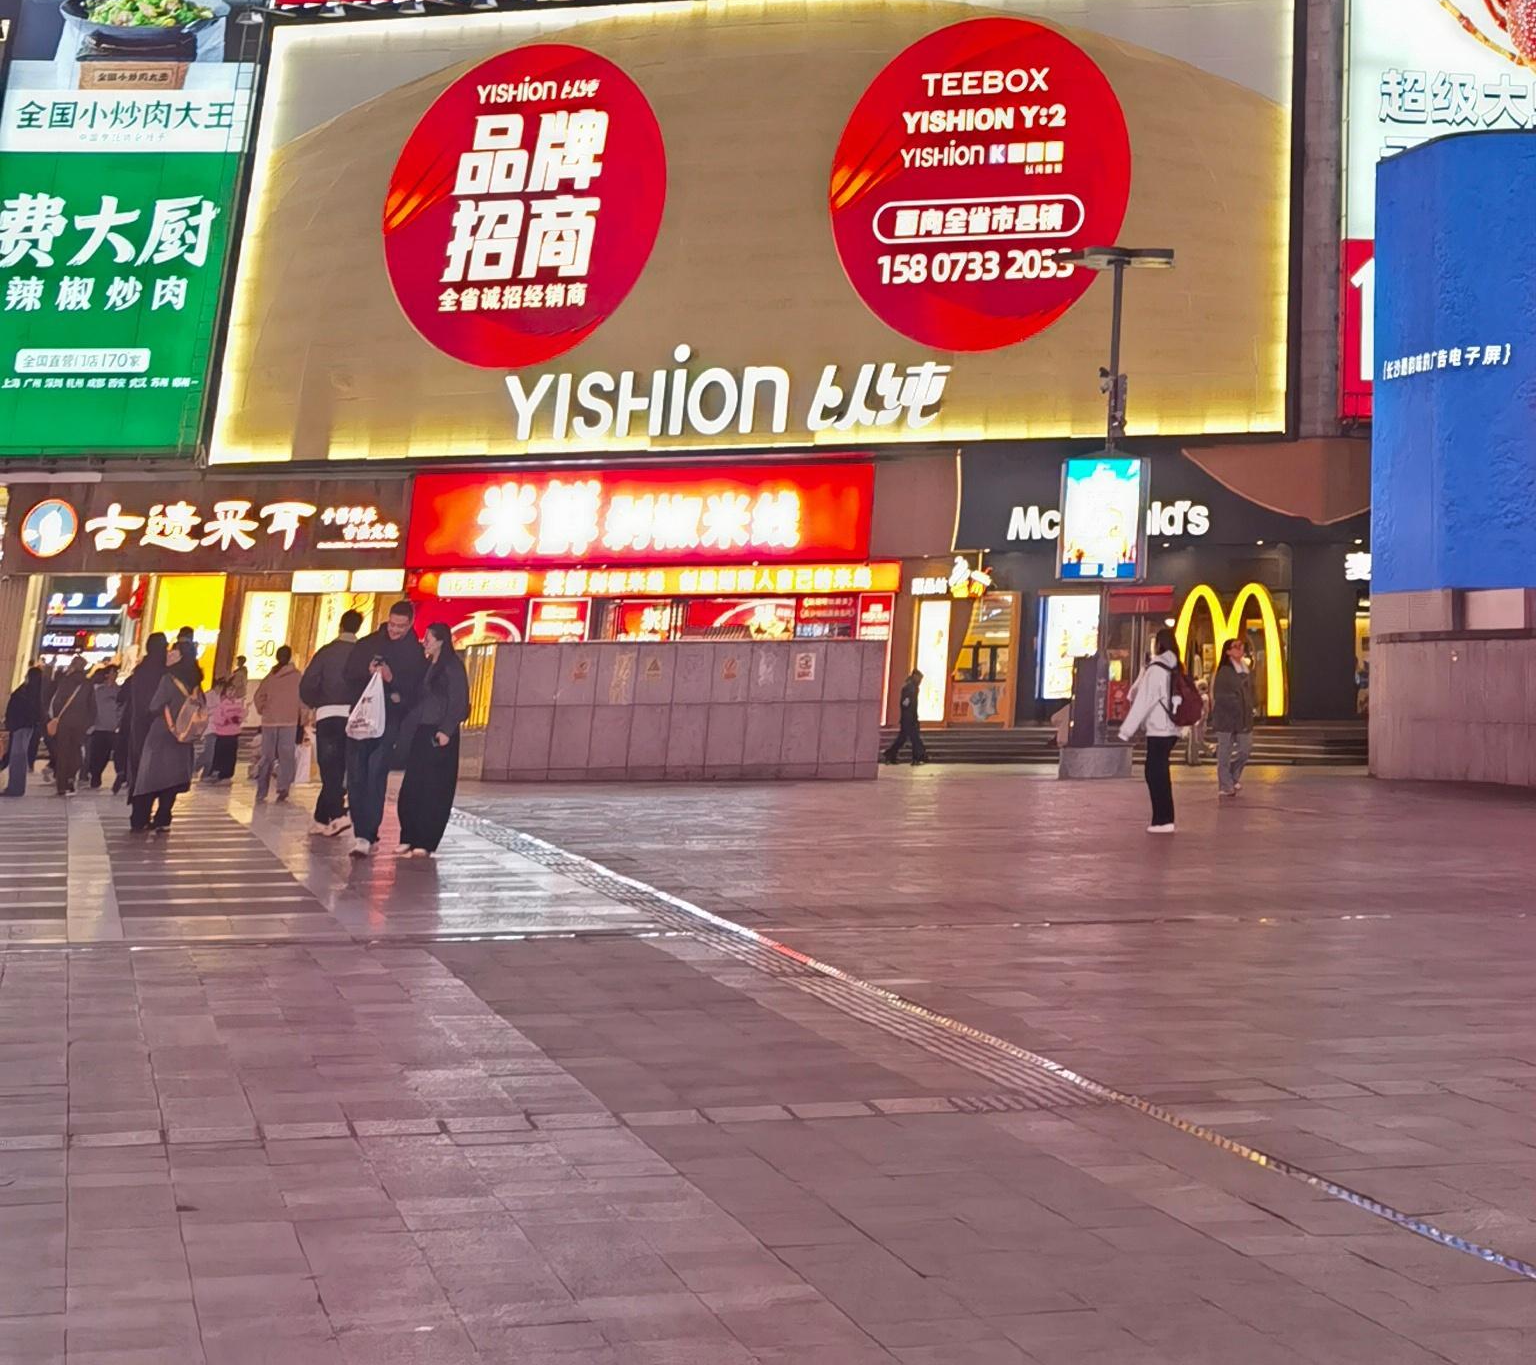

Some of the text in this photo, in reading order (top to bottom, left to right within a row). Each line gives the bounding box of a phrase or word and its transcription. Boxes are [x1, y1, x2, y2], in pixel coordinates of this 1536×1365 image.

[922, 67, 1050, 97] TEEBOX
[16, 99, 235, 131] 全国小炒肉大王
[902, 104, 1067, 134] YISHION Y:2
[451, 109, 610, 196] 品牌
[0, 192, 221, 268] 费大厨
[439, 195, 601, 283] 招商
[877, 254, 928, 285] 158
[931, 250, 1001, 282] 0733
[5, 276, 189, 312] 辣椒炒肉
[437, 283, 588, 312] 全省诚招经销商
